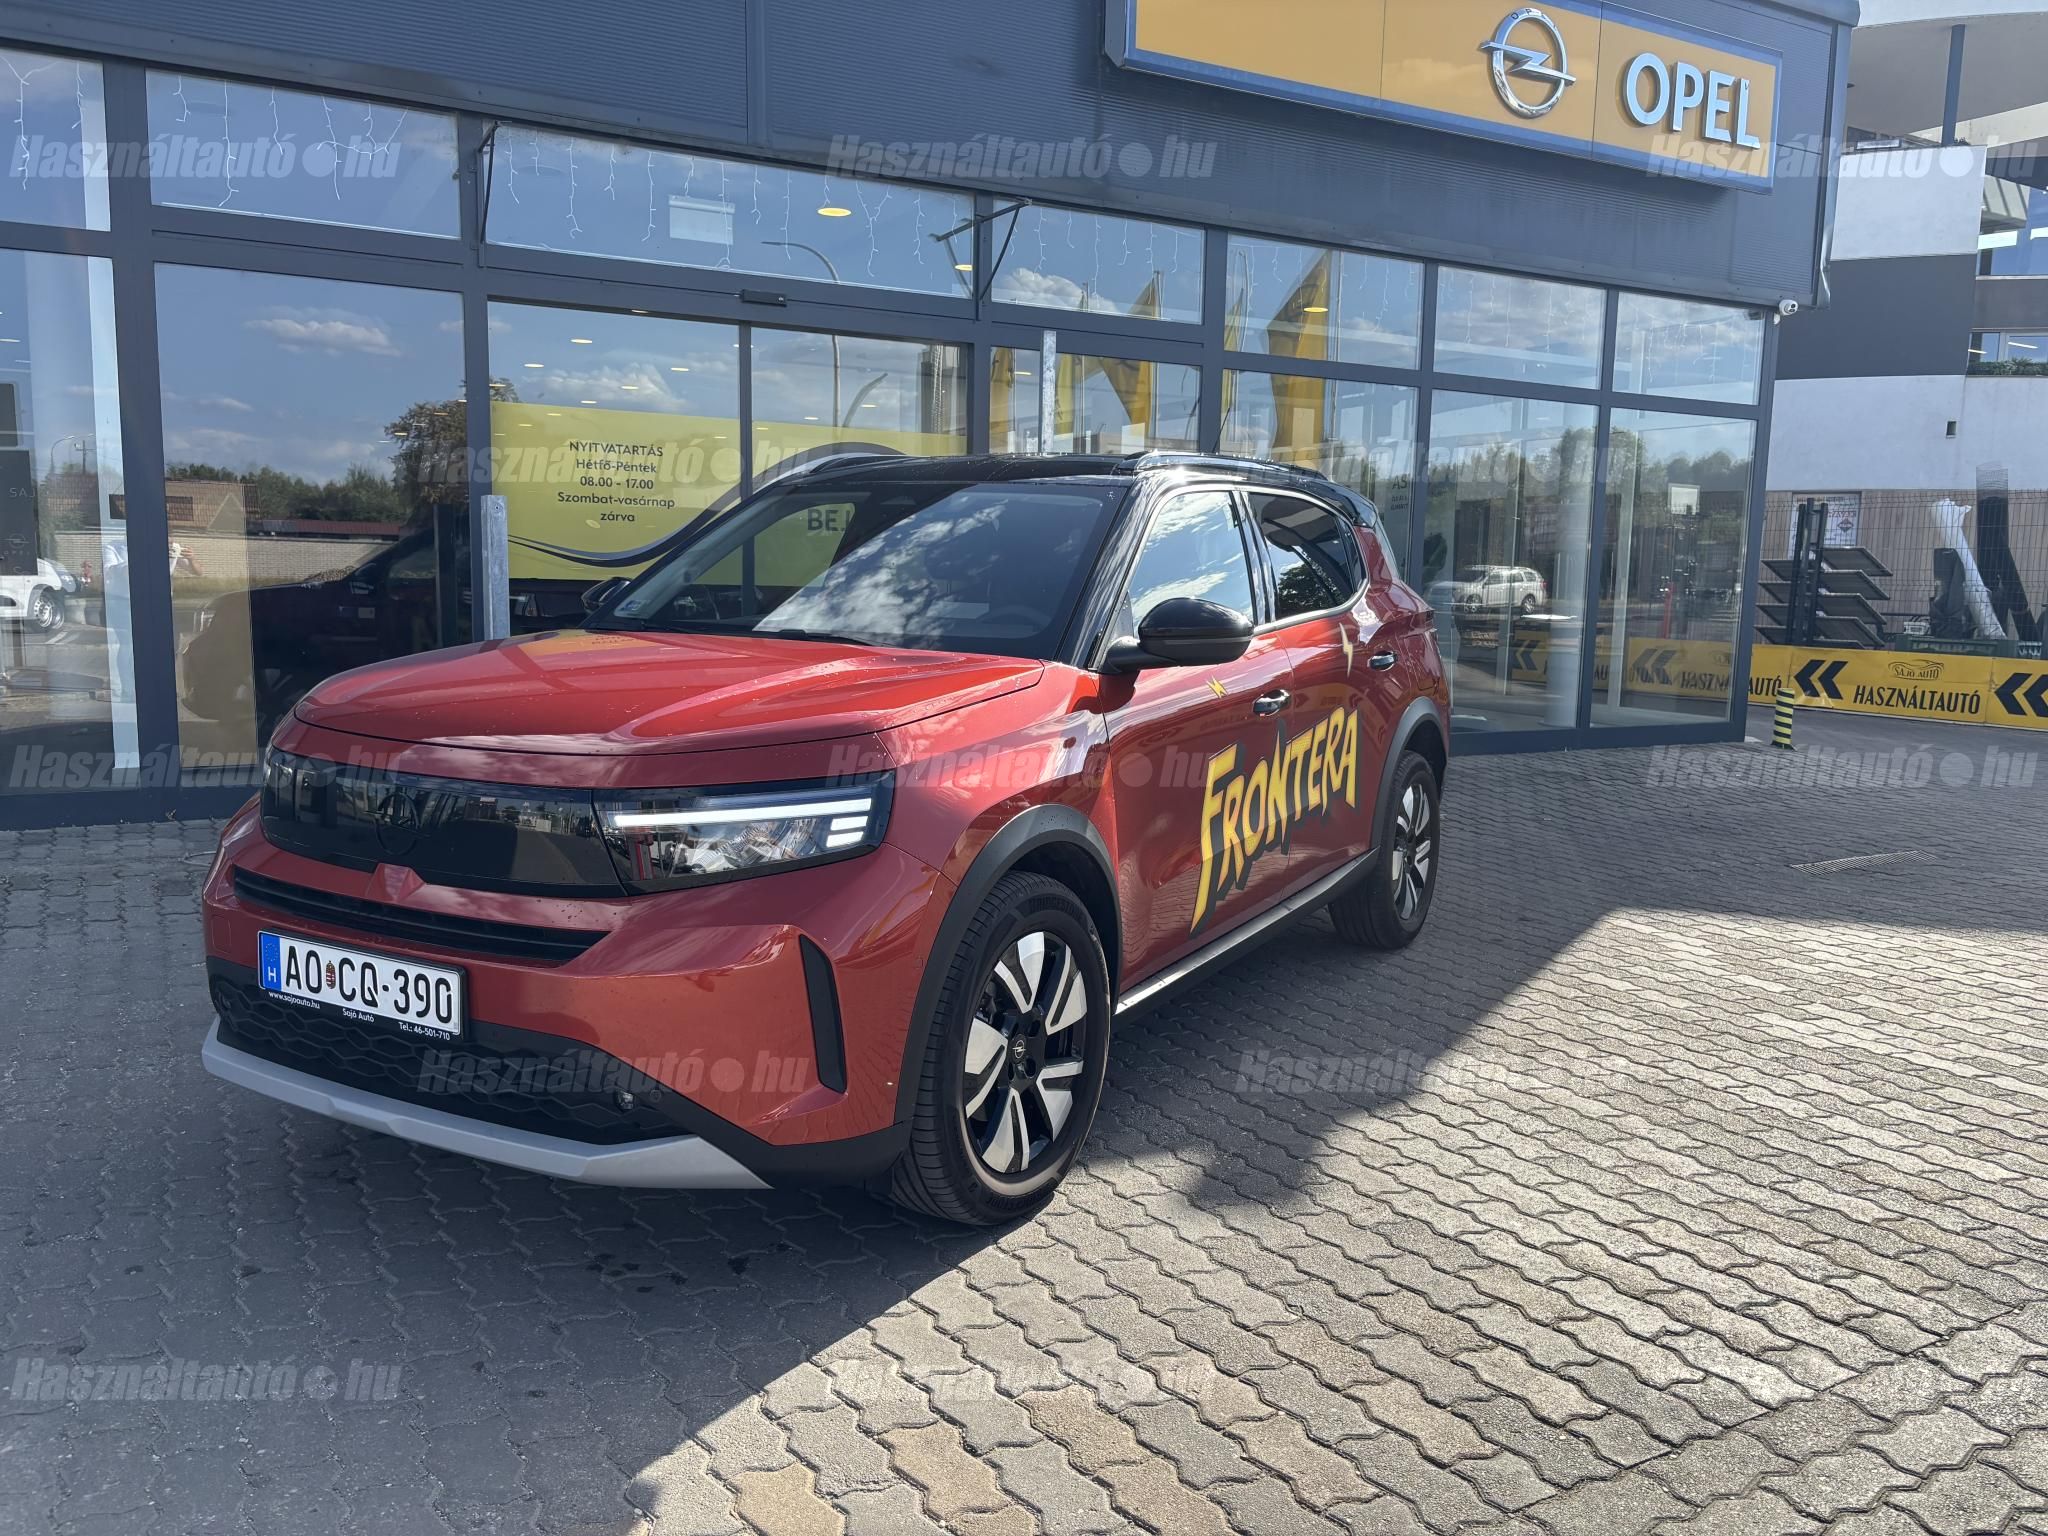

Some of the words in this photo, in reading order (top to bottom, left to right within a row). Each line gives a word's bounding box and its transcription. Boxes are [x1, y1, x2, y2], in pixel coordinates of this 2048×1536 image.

[1625, 52, 1761, 149] OPEL
[569, 440, 664, 457] NYITVATARTÁS
[576, 458, 657, 473] Hétfő-Péntek
[580, 476, 613, 488] 08.00
[625, 478, 654, 489] 17.00
[557, 491, 676, 509] Szombat-vasárnap
[600, 511, 636, 522] zárva
[1853, 684, 1981, 715] HASZNÁLTAUTÓ
[1189, 706, 1360, 936] FRONTERA
[268, 966, 277, 983] H
[358, 1010, 375, 1023] Autó
[413, 1025, 451, 1041] 46-501-710
